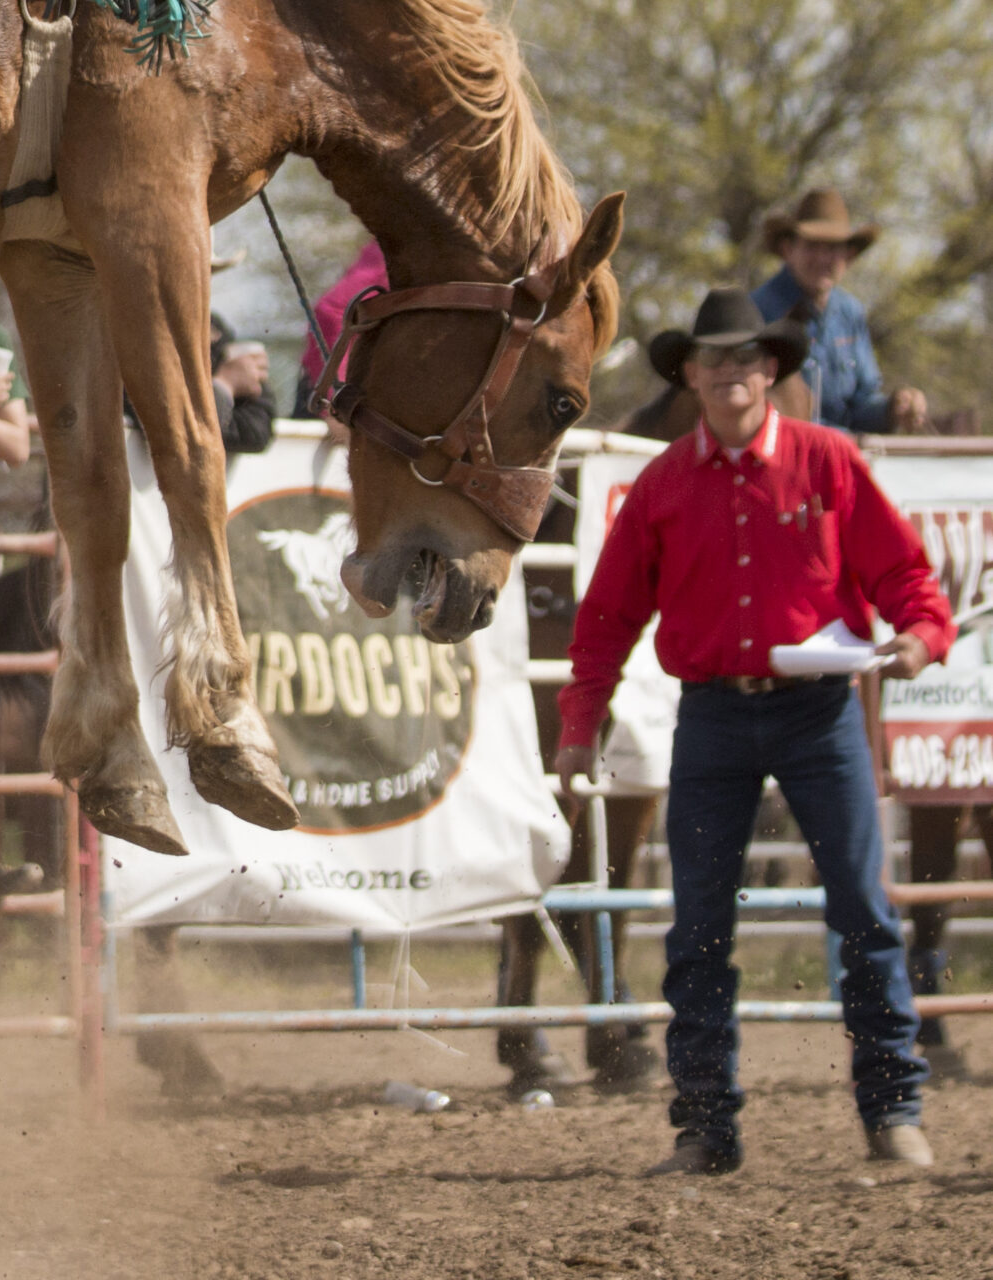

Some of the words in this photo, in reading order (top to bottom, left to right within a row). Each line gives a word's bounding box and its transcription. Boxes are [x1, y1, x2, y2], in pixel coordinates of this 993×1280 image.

[310, 780, 373, 808] HOME
[375, 748, 441, 803] SUPPLY
[273, 860, 433, 891] Welcome
